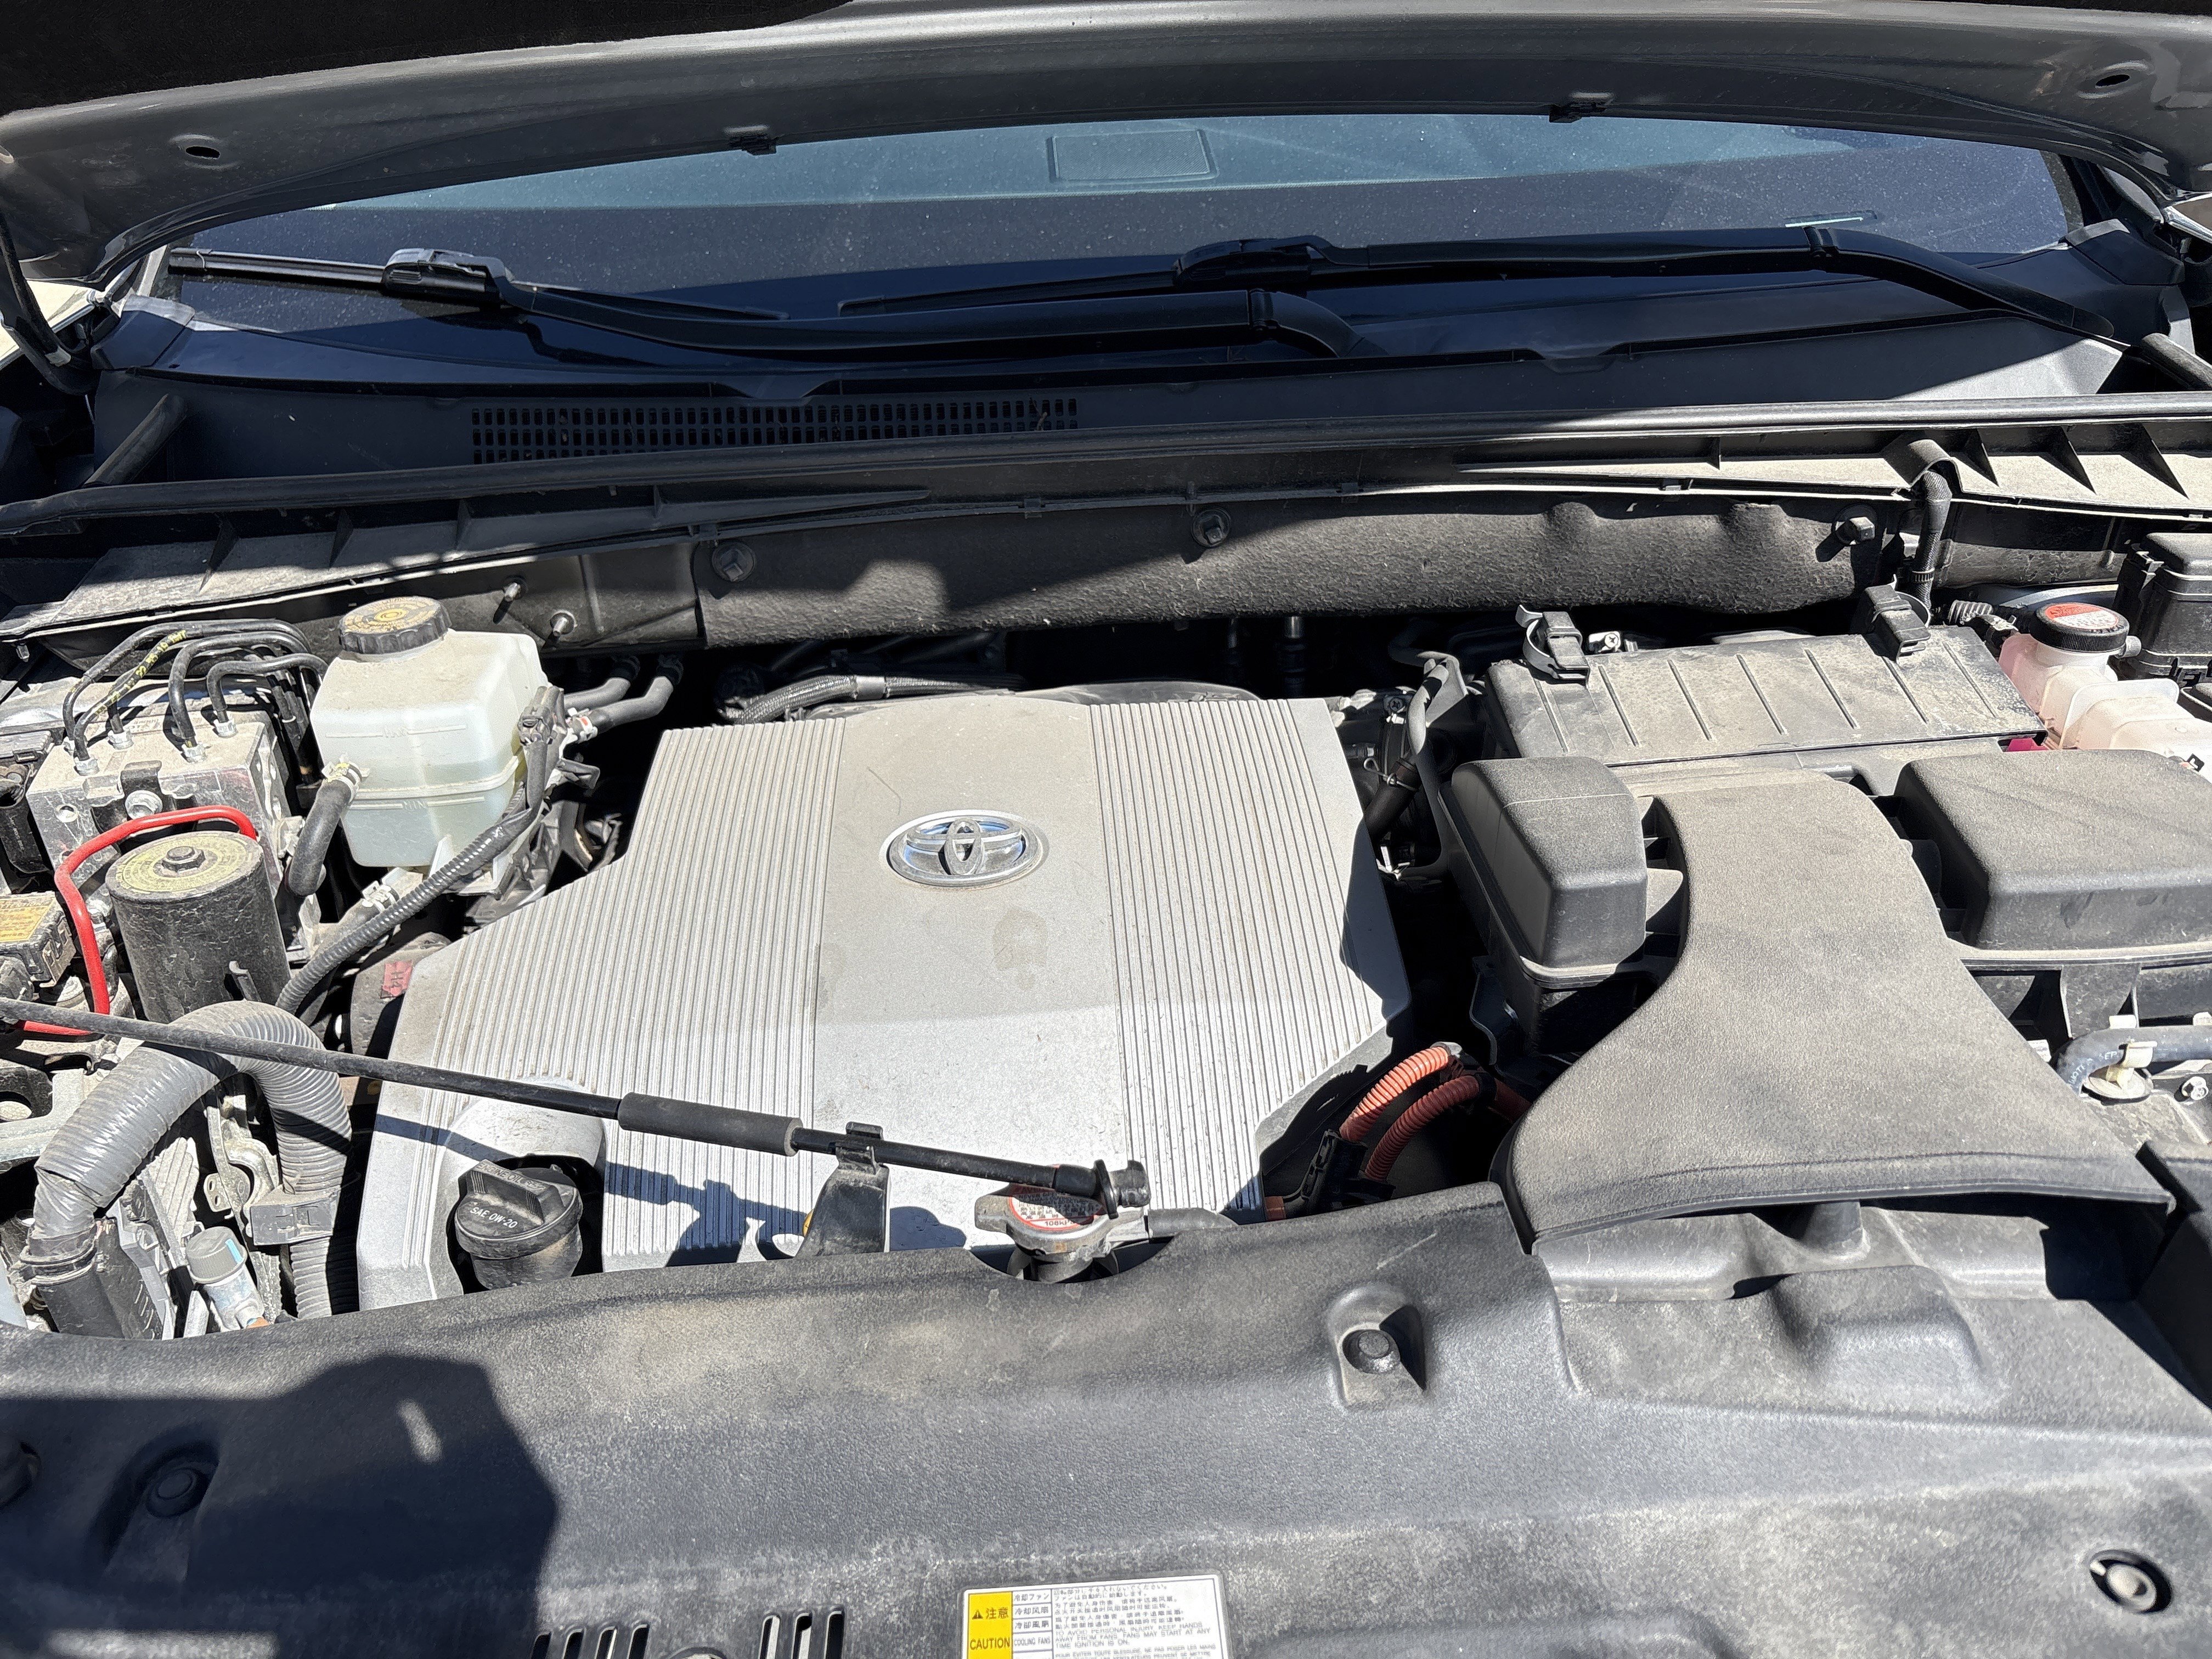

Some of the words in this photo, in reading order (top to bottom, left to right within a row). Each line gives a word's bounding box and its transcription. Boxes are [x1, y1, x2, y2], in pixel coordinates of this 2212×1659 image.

[476, 1161, 506, 1177] ENGINE
[507, 1171, 523, 1183] OIL
[470, 1207, 489, 1217] SAE
[488, 1213, 518, 1228] 0W-20
[1014, 1593, 1049, 1601] 冷却ファン
[986, 1607, 1008, 1620] 注意
[1015, 1606, 1048, 1615] 冷却风扇
[1015, 1621, 1049, 1629] 冷卻風扇
[970, 1637, 1010, 1650] CAUTION
[1014, 1637, 1035, 1646] COOLING
